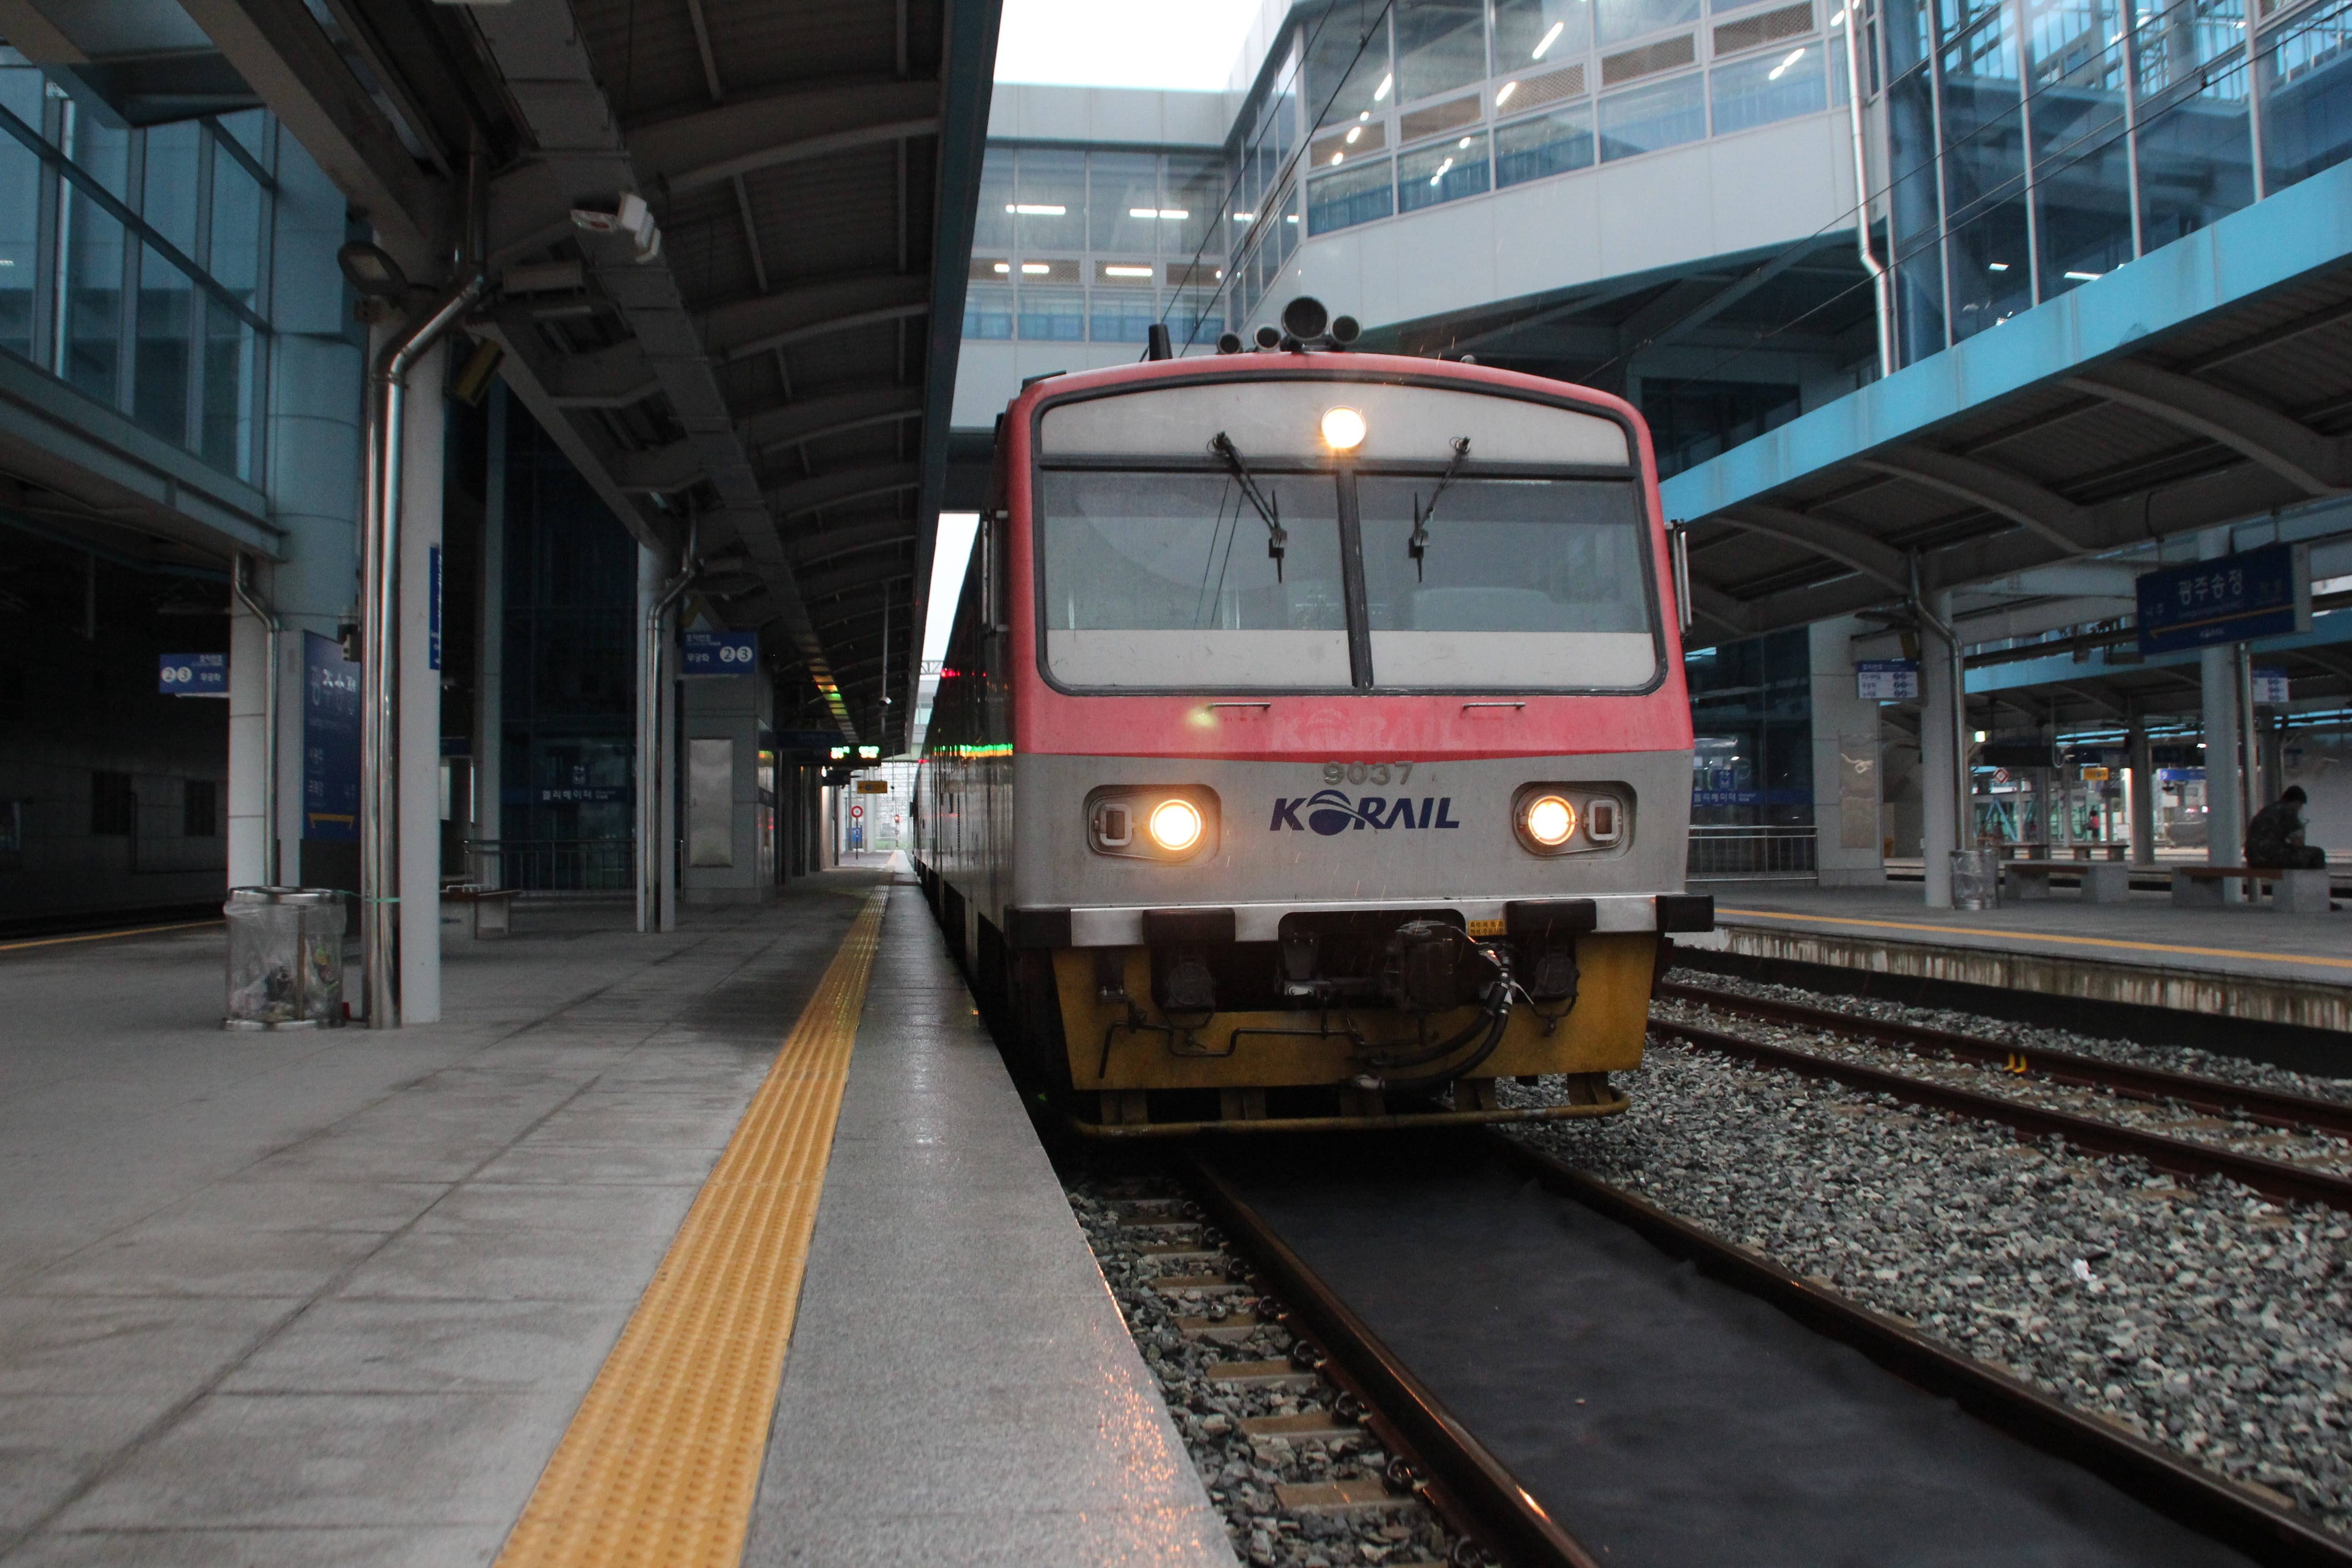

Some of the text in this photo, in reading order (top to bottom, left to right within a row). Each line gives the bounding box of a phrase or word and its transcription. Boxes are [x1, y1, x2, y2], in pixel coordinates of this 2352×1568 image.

[2178, 569, 2243, 605] 광주송정
[1323, 760, 1414, 785] 9037
[542, 790, 592, 800] 엘리베이터
[1694, 793, 1736, 803] 엘리베이터
[1269, 789, 1460, 836] KORAIL
